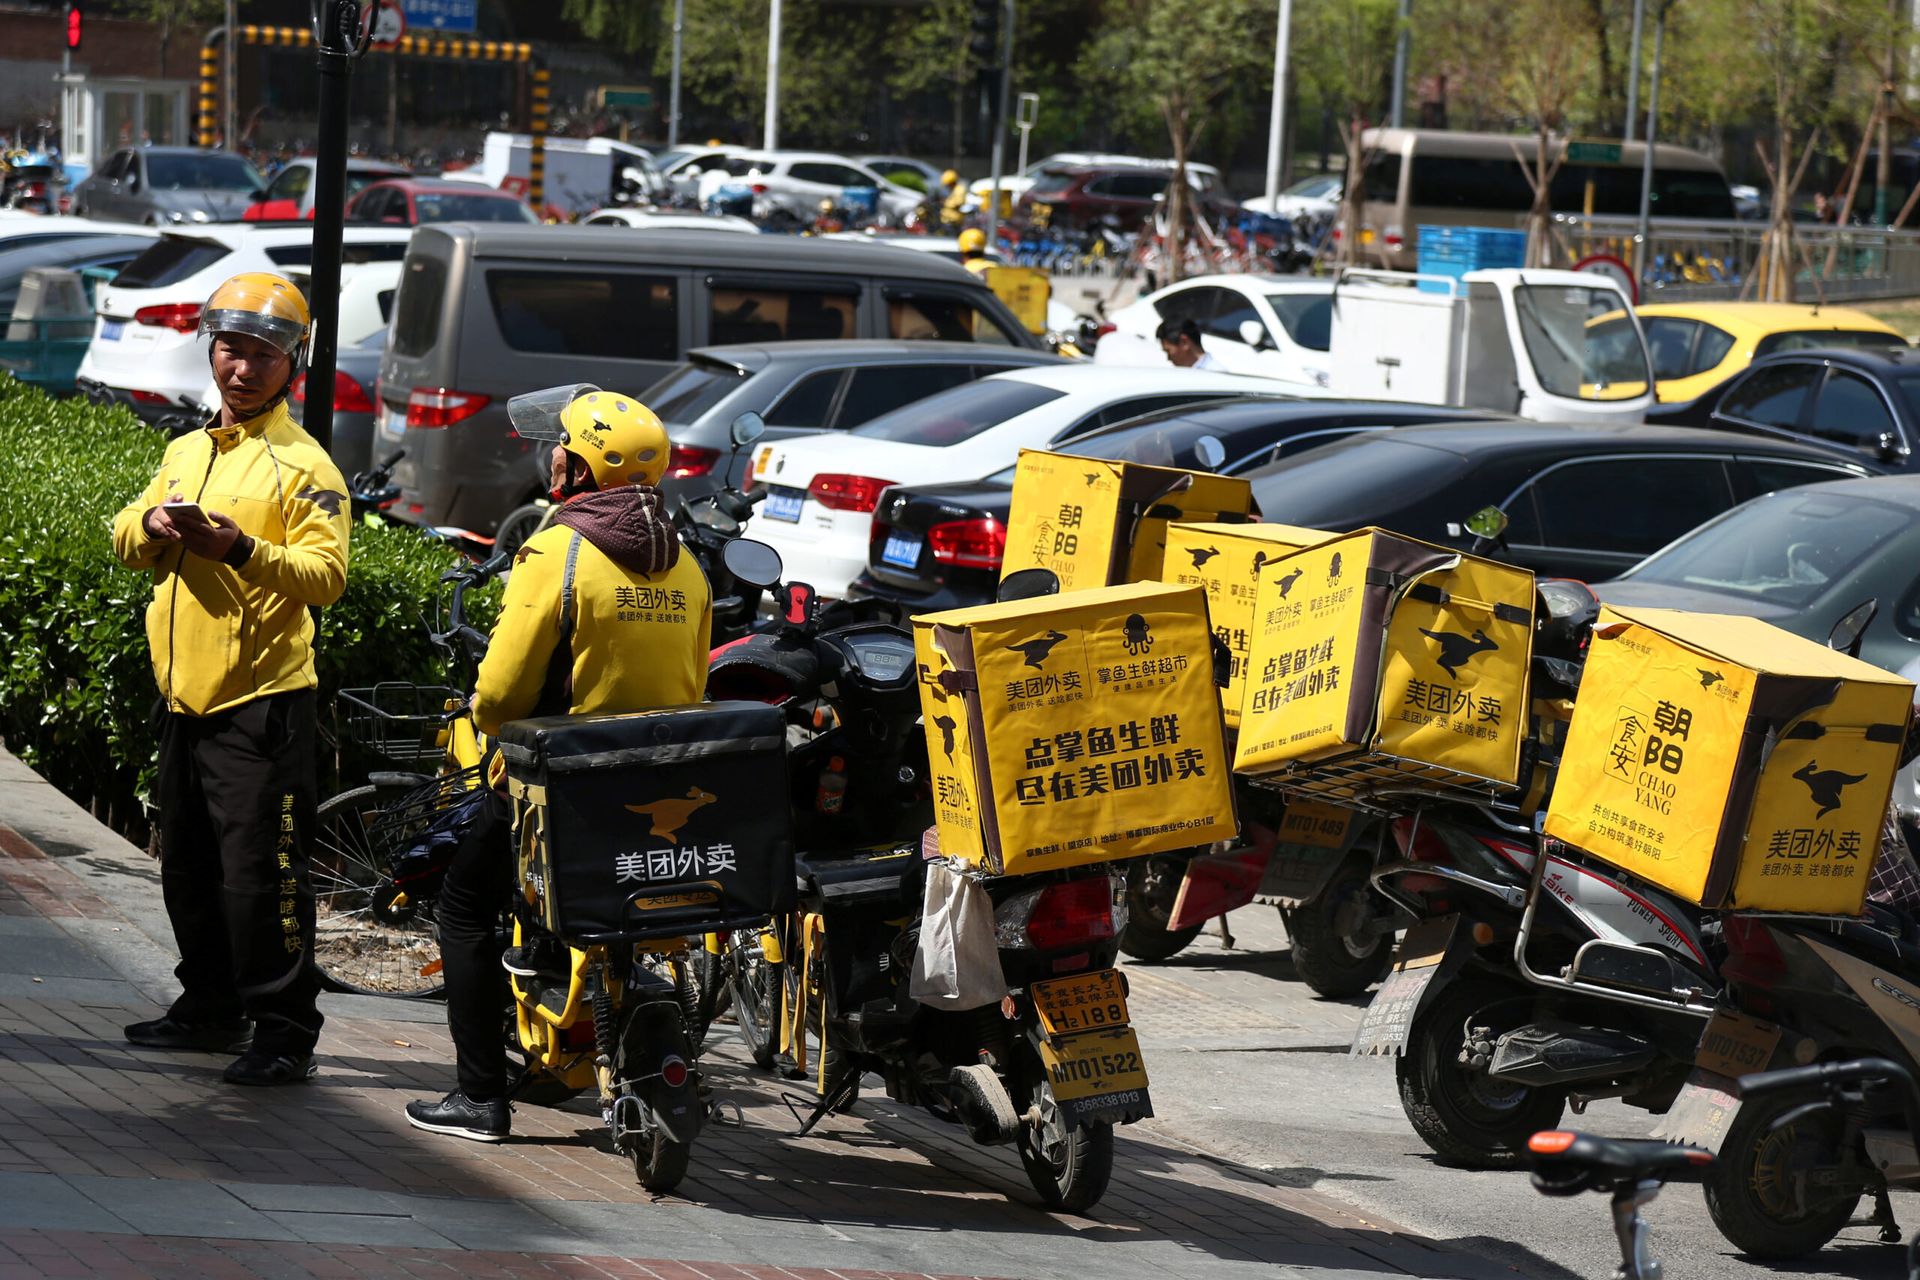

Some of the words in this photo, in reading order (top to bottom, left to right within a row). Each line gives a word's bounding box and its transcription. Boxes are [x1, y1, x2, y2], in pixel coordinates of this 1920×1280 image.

[615, 586, 686, 611] 美团外卖
[1265, 601, 1302, 627] 美团外卖
[1096, 654, 1188, 685] 掌鱼生鲜超市
[1262, 635, 1335, 684] 点掌鱼生鲜
[1005, 671, 1082, 701] 美团外卖
[1008, 699, 1045, 713] 美团外卖
[1047, 692, 1084, 707] 送啥都快
[1252, 665, 1340, 714] 尽在美团外卖
[1404, 678, 1501, 726] 美团外卖
[1025, 713, 1182, 770] 点掌鱼生鲜
[1400, 709, 1448, 729] 美团外卖
[1452, 720, 1498, 742] 送啥都快
[1643, 700, 1692, 775] 朝阳
[1015, 748, 1207, 806] 尽在美团外卖
[1638, 771, 1676, 799] CHAO
[1635, 787, 1672, 816] YANG
[277, 794, 294, 869] 美团外卖
[1588, 819, 1662, 861] 合力构筑美好朝阳
[1592, 803, 1665, 845] 共创共享食药安全
[1766, 828, 1861, 860] 美团外卖
[615, 843, 737, 884] 美团外卖
[1760, 862, 1804, 877] 美团外卖
[1808, 863, 1855, 878] 送啥都快
[280, 877, 302, 953] 送啥都快
[1627, 898, 1656, 925] POWER
[1658, 922, 1684, 948] SPORT
[1051, 1051, 1140, 1084] MT01522
[1073, 1091, 1140, 1113] 13683381013
